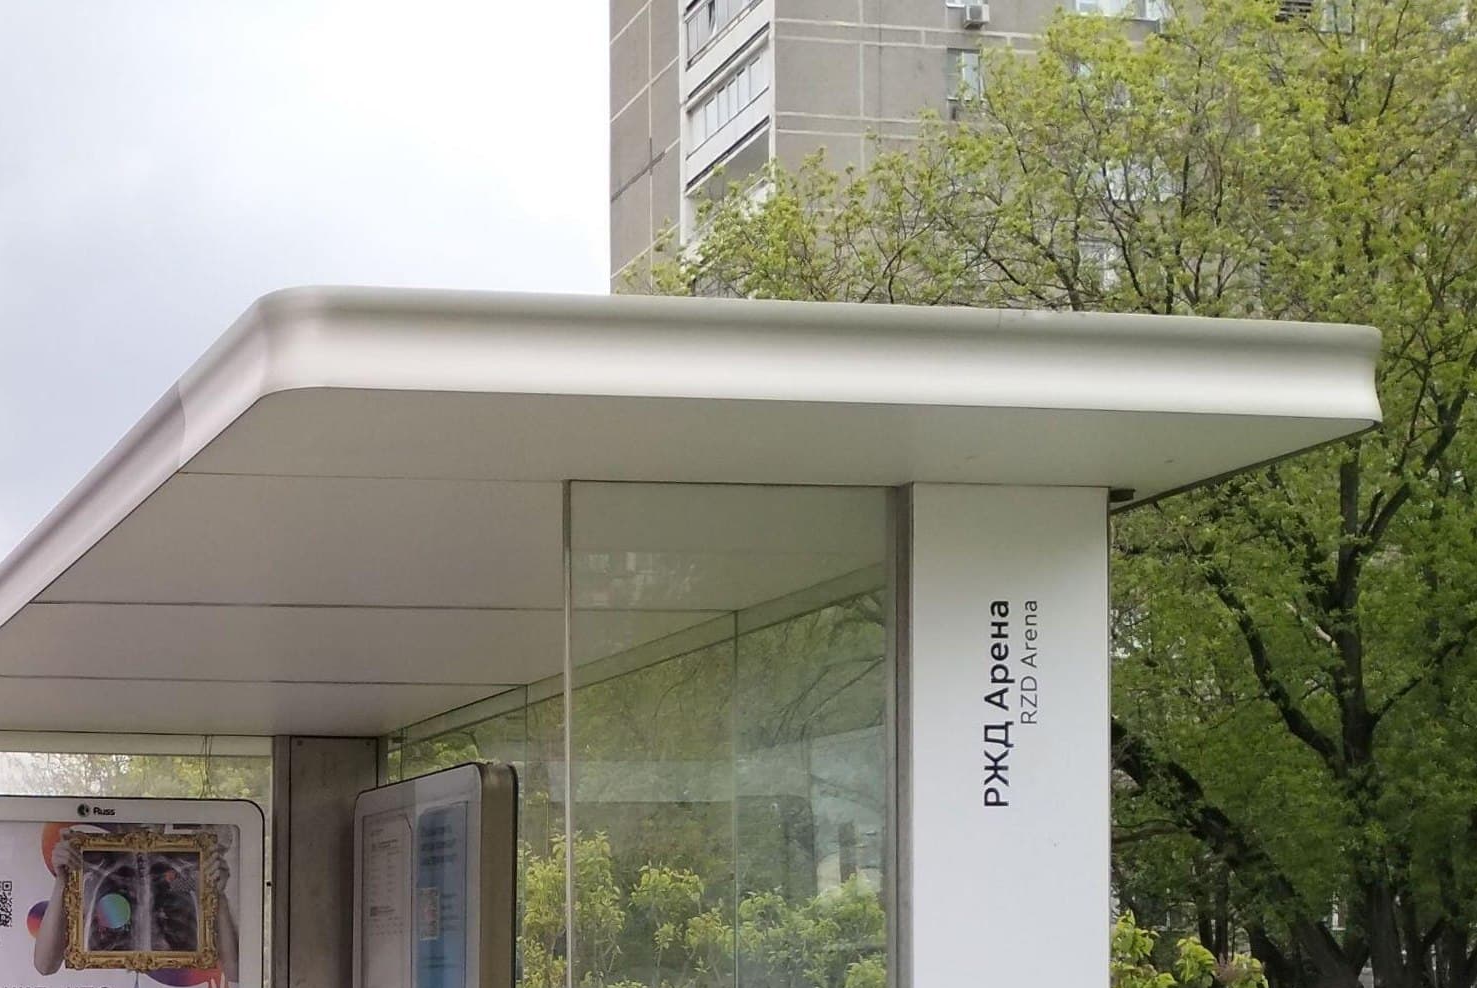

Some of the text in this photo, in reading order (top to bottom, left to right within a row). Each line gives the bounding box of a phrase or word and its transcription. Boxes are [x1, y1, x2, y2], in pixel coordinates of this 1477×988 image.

[983, 600, 1015, 807] РЖД Арена
[1020, 600, 1038, 725] RZD Arena
